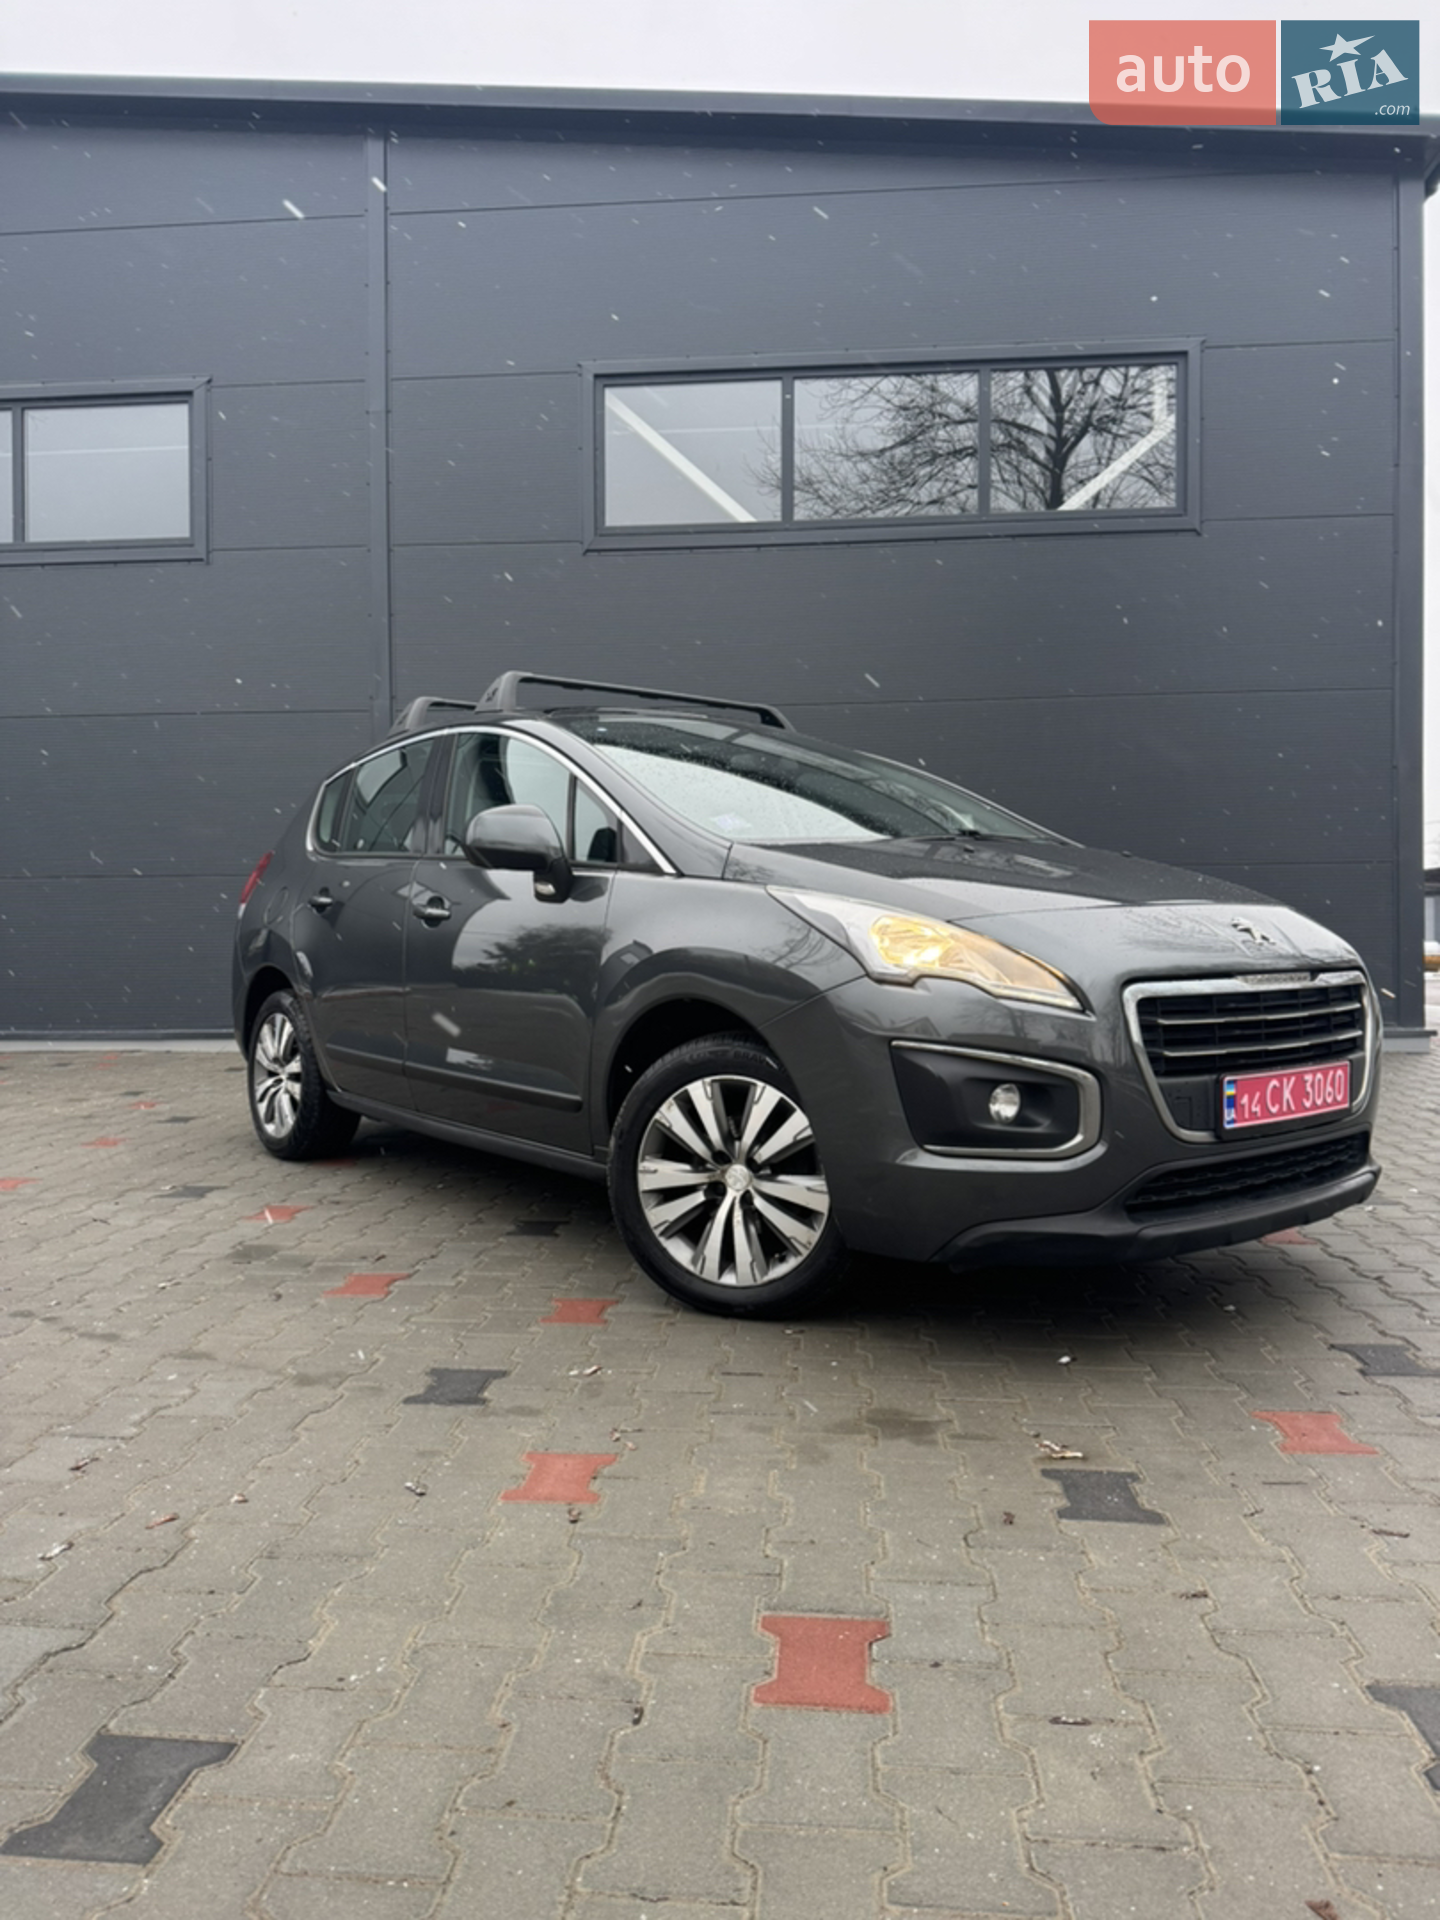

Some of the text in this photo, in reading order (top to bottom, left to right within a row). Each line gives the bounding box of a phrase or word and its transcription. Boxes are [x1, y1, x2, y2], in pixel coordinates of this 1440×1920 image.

[1240, 1069, 1345, 1120] 14 CK 3060
